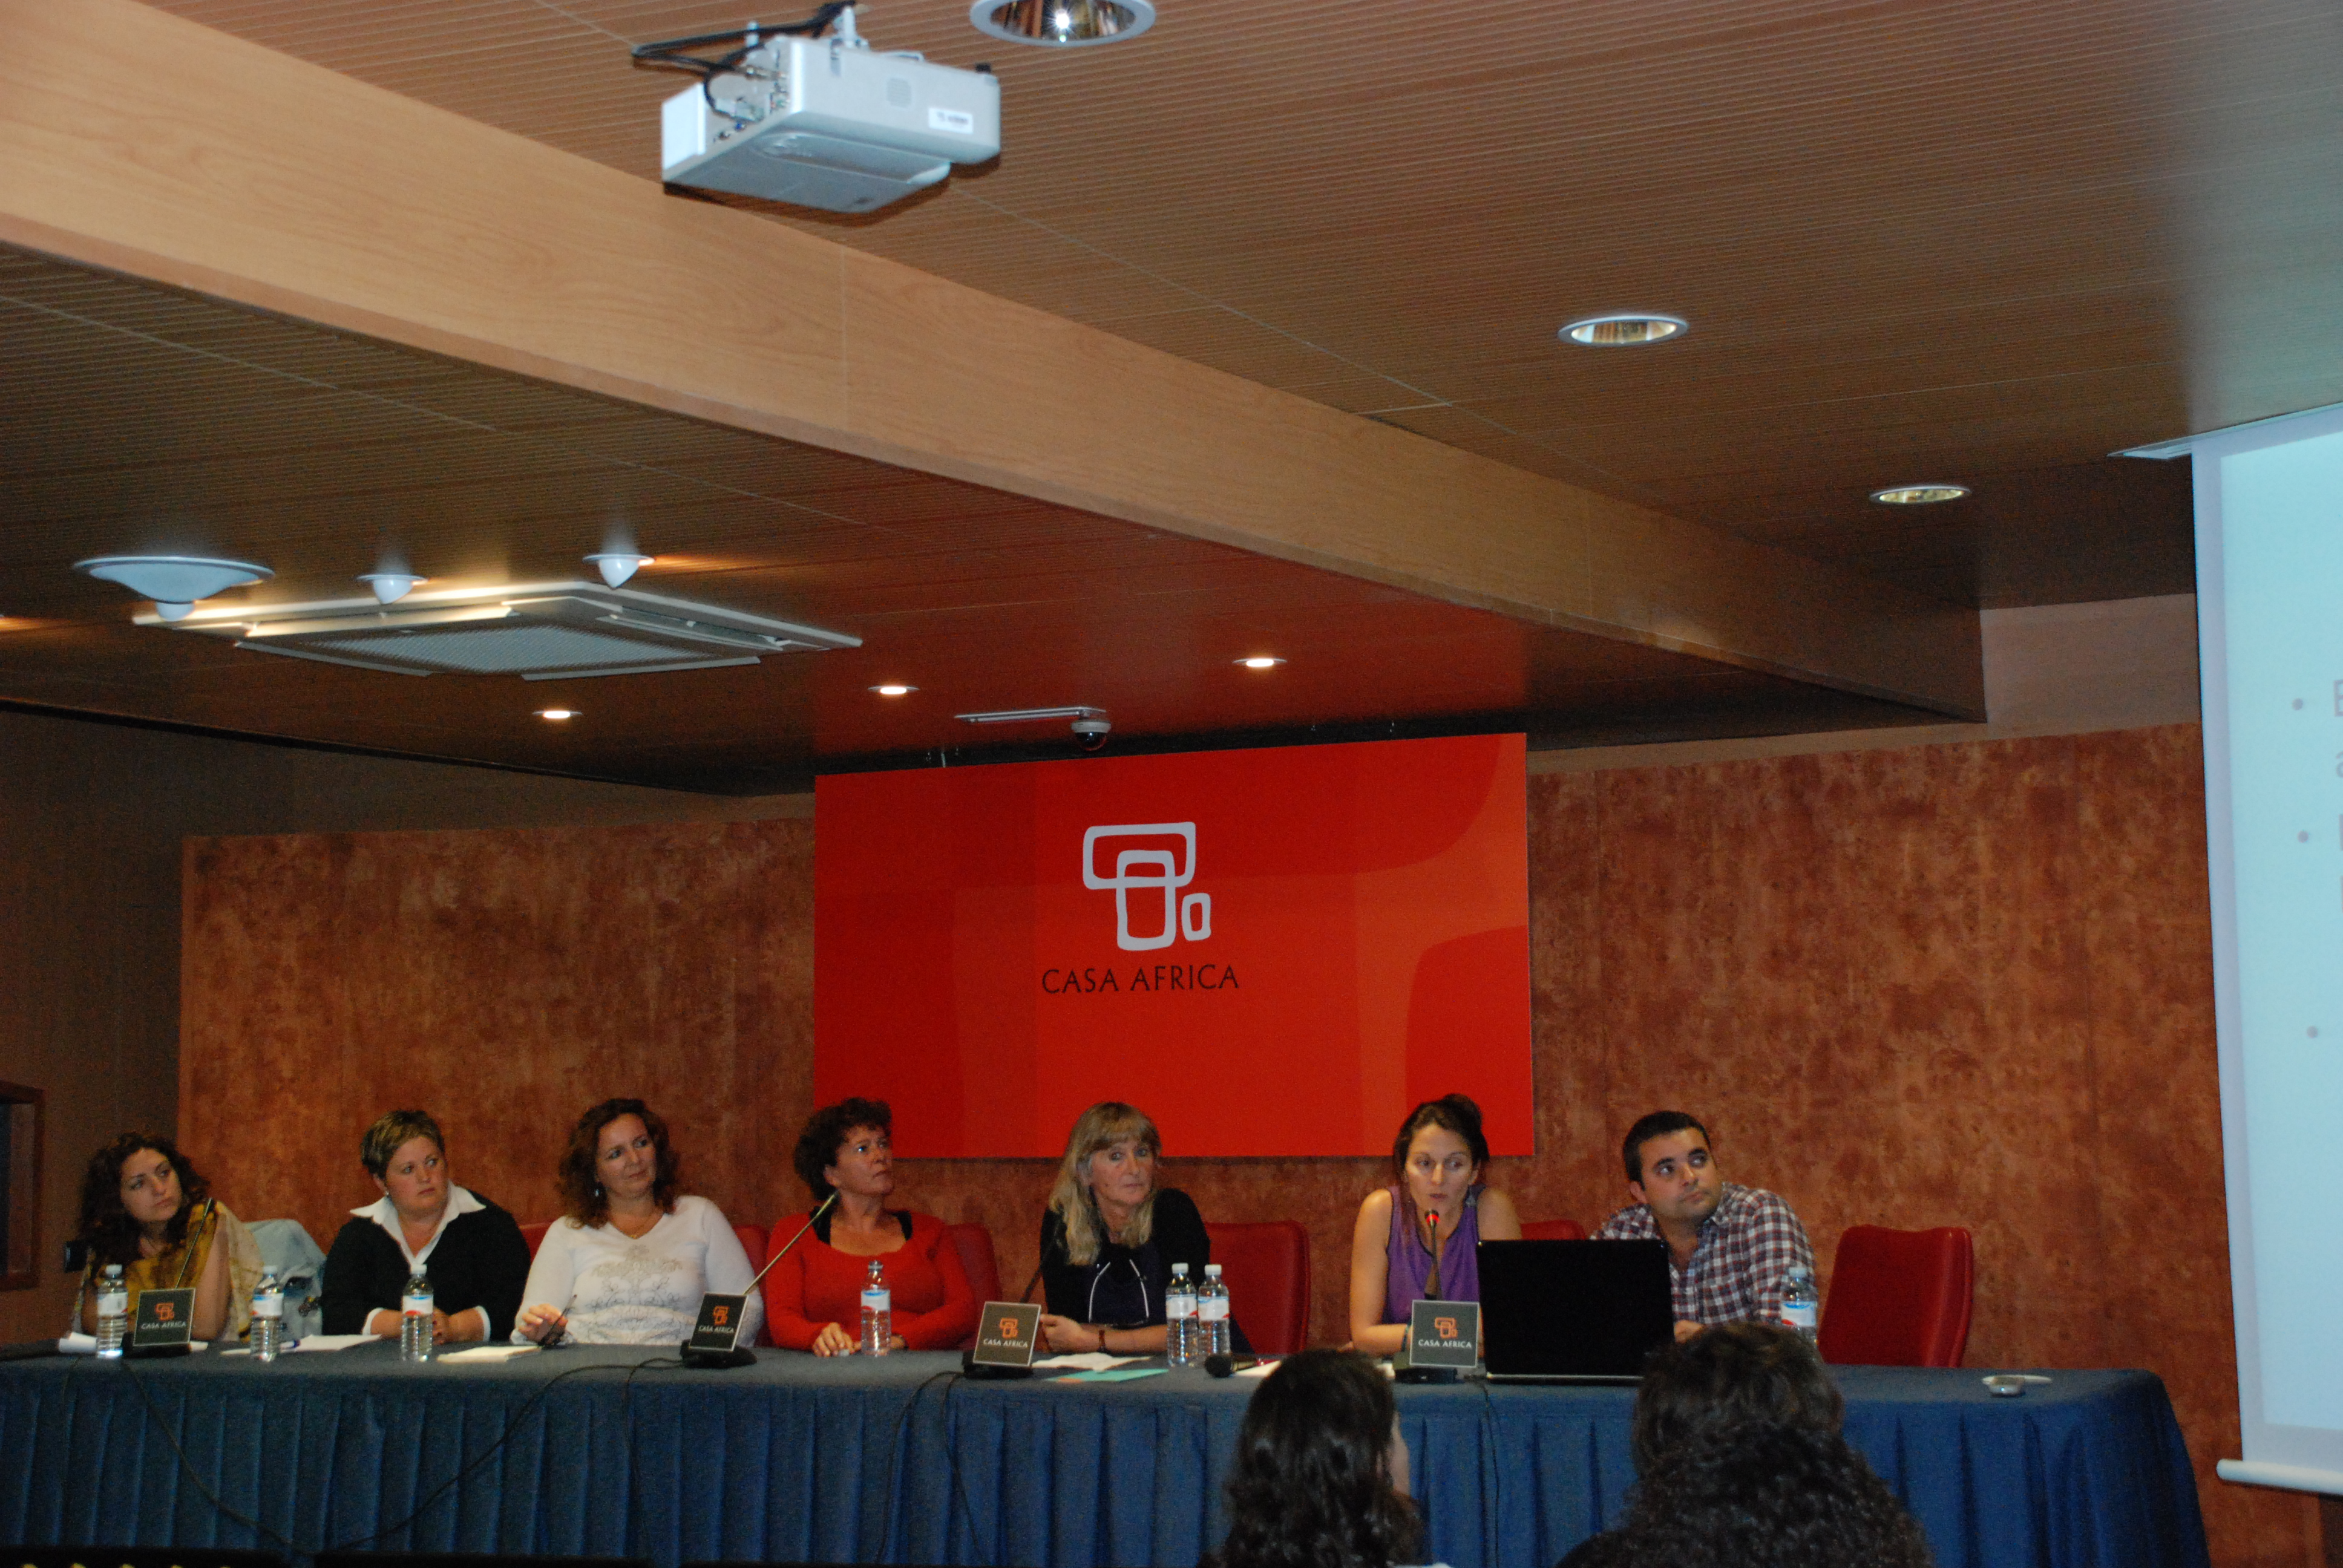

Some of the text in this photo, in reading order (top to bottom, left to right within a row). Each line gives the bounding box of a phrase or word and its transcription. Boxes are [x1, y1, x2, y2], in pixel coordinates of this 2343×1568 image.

[1041, 964, 1239, 994] CASA AFRICA
[1003, 1339, 1028, 1348] AFRICA
[1442, 1340, 1472, 1348] AFRICA
